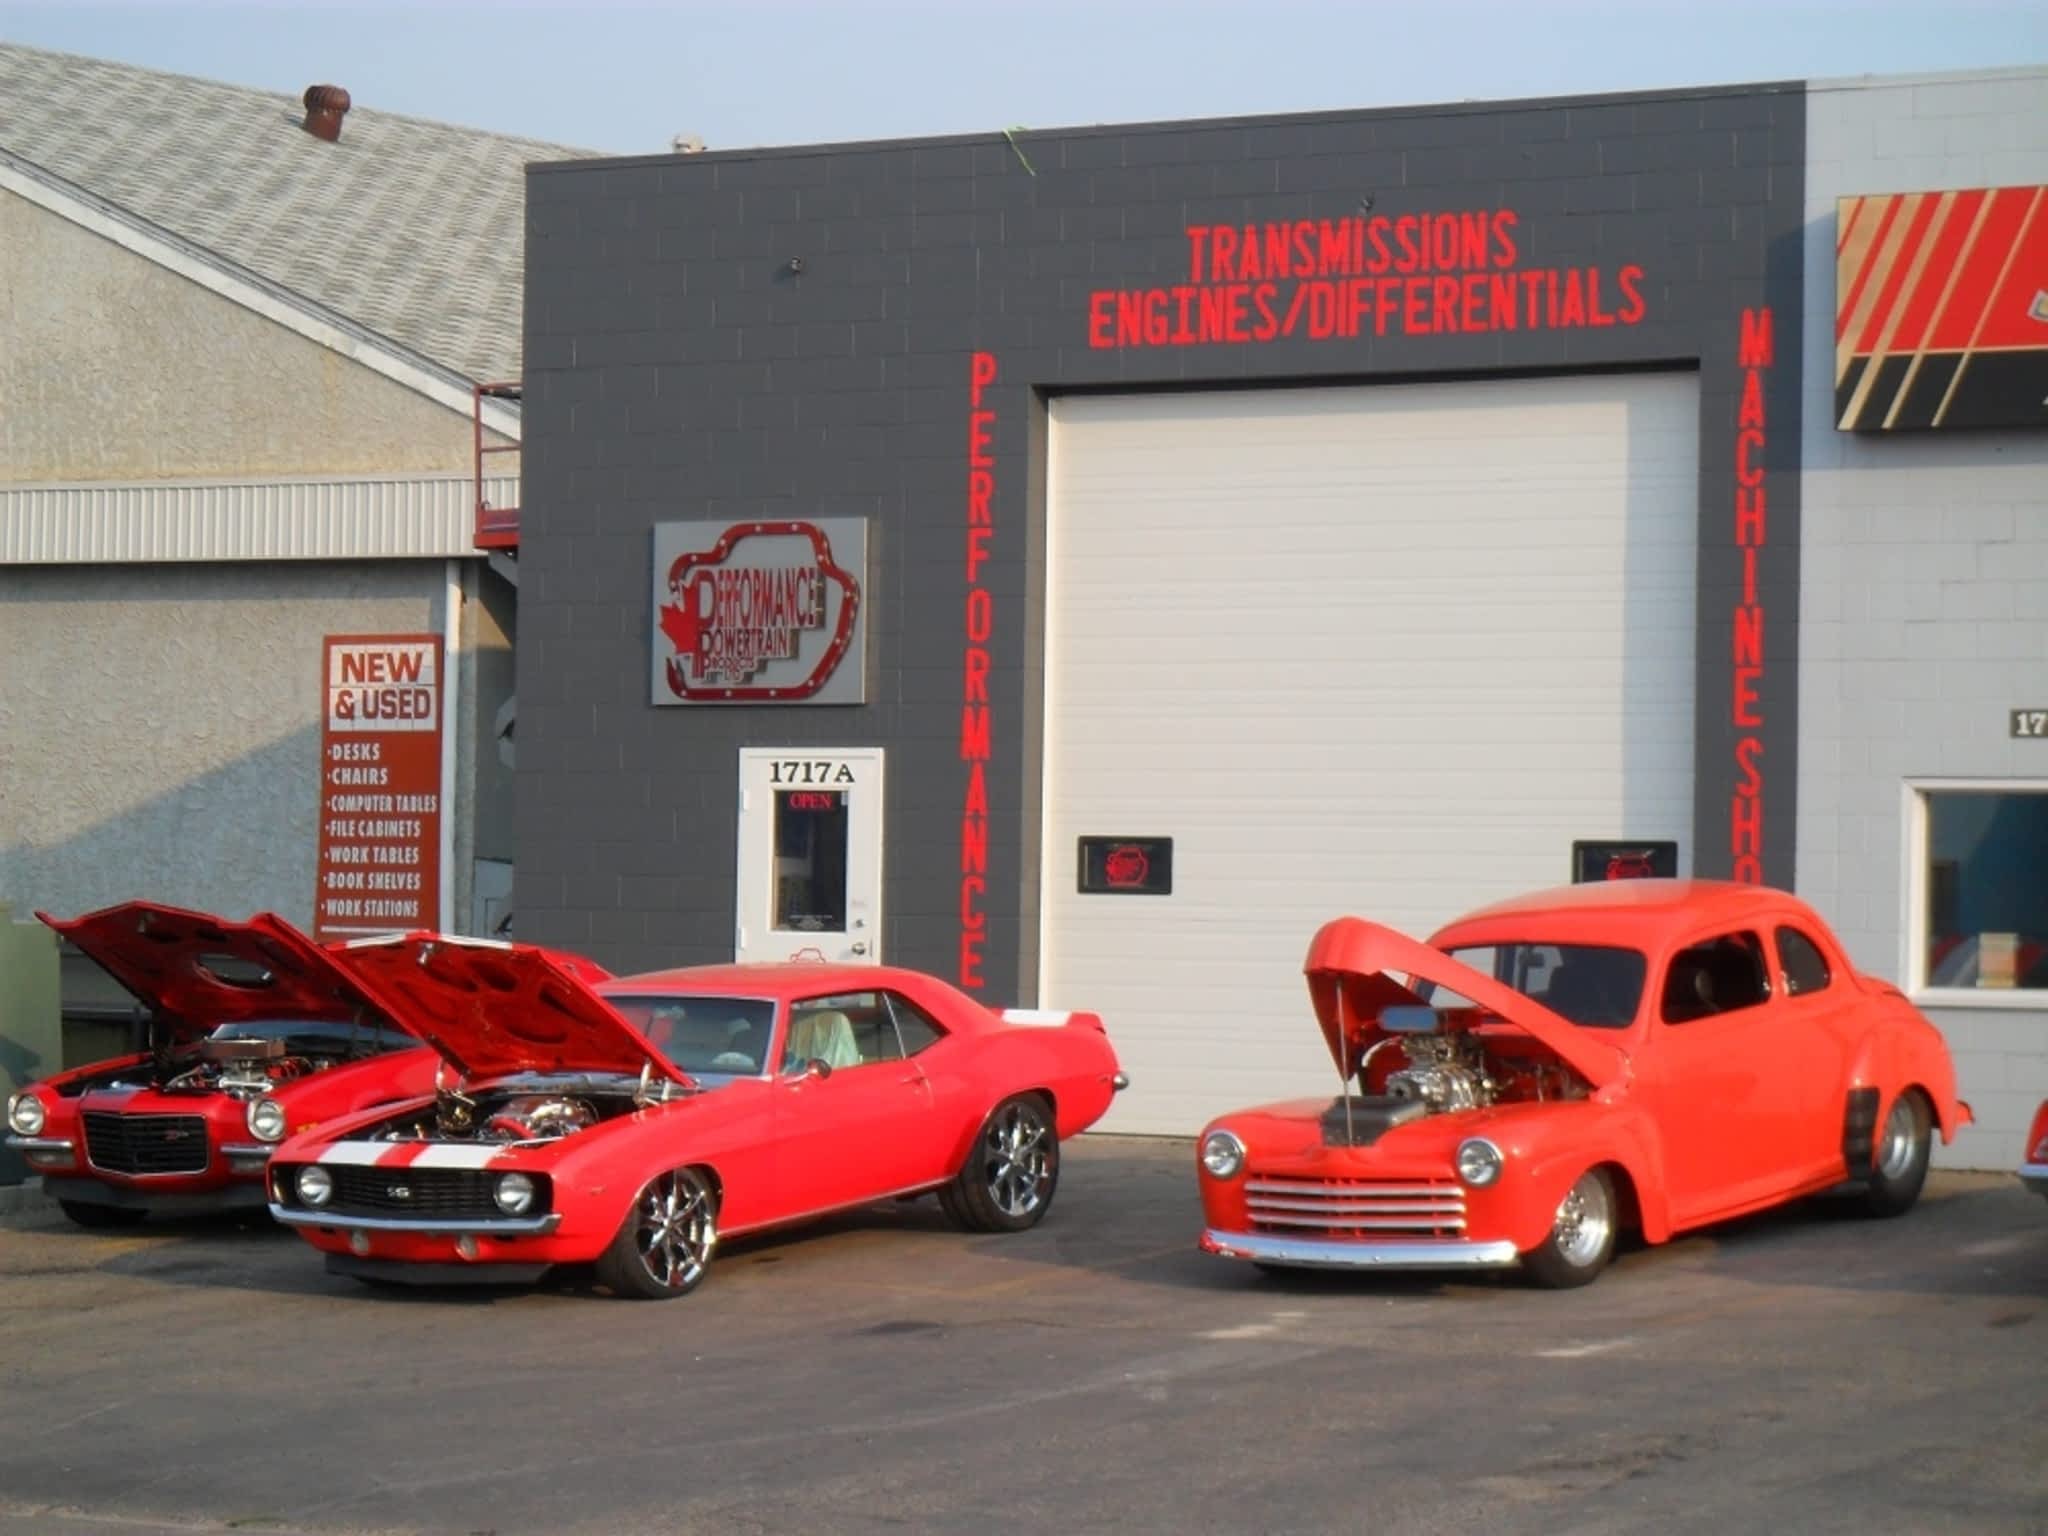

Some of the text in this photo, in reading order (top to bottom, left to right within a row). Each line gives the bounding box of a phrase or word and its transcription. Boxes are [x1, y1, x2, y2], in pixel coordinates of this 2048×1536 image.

[1186, 209, 1518, 283] TRANSMISSIONS
[1089, 265, 1646, 349] ENGINES/DIFFERENTIALS
[1731, 308, 1773, 727] MACHINE
[695, 568, 816, 628] PERFORMANCE
[697, 628, 788, 658] POWERTRAIN
[341, 652, 423, 683] NEW
[959, 352, 997, 987] PERFORMANCE
[335, 689, 431, 720] & USED
[332, 743, 380, 761] DESKS
[332, 767, 388, 786] CHAIRS
[769, 761, 855, 783] 1717A
[331, 795, 438, 813] COMPUTER TABLES
[790, 792, 833, 809] OPEN
[330, 820, 421, 838] FILE CABINETS
[330, 846, 420, 864] WORK TABLES
[327, 872, 421, 890] BOOK SHELVES
[327, 899, 419, 918] WORK STATIONS
